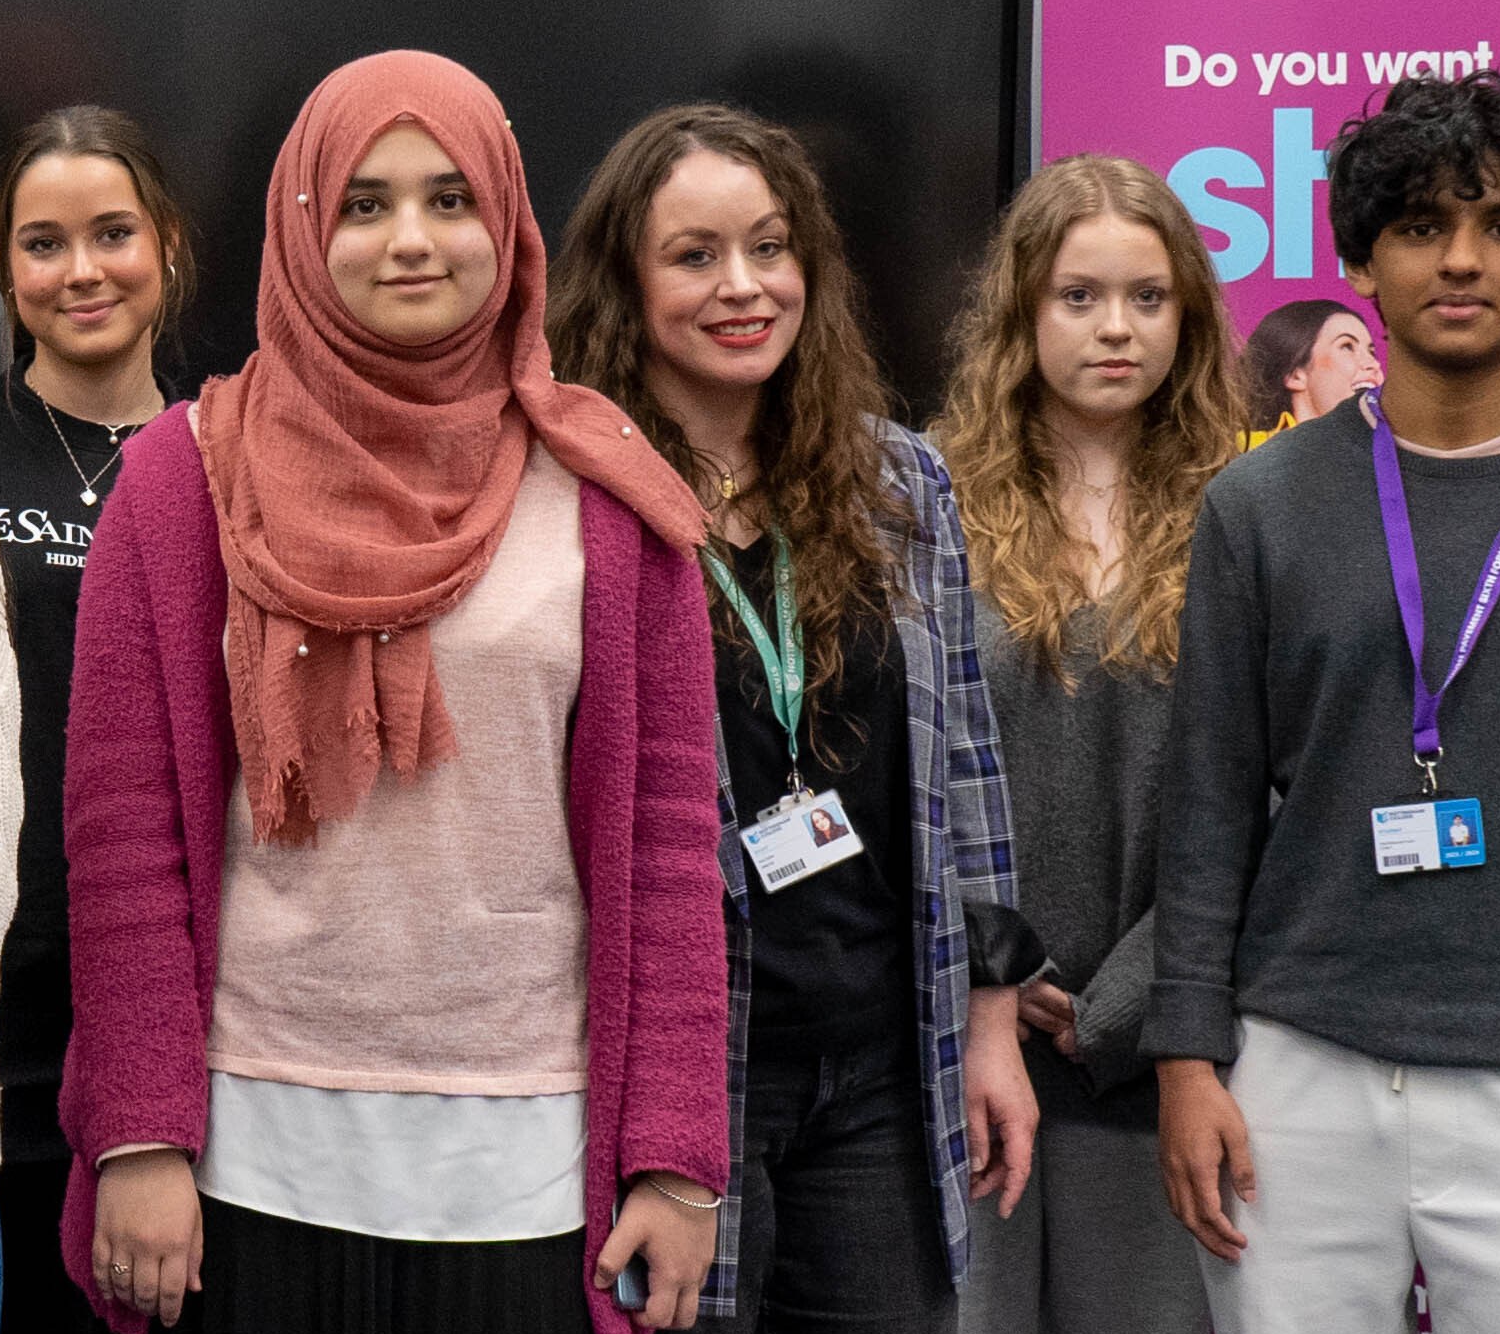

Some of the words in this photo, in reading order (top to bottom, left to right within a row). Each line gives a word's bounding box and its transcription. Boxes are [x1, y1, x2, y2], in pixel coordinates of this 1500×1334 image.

[1165, 45, 1237, 88] Do
[1252, 50, 1354, 96] you
[1363, 41, 1494, 84] want
